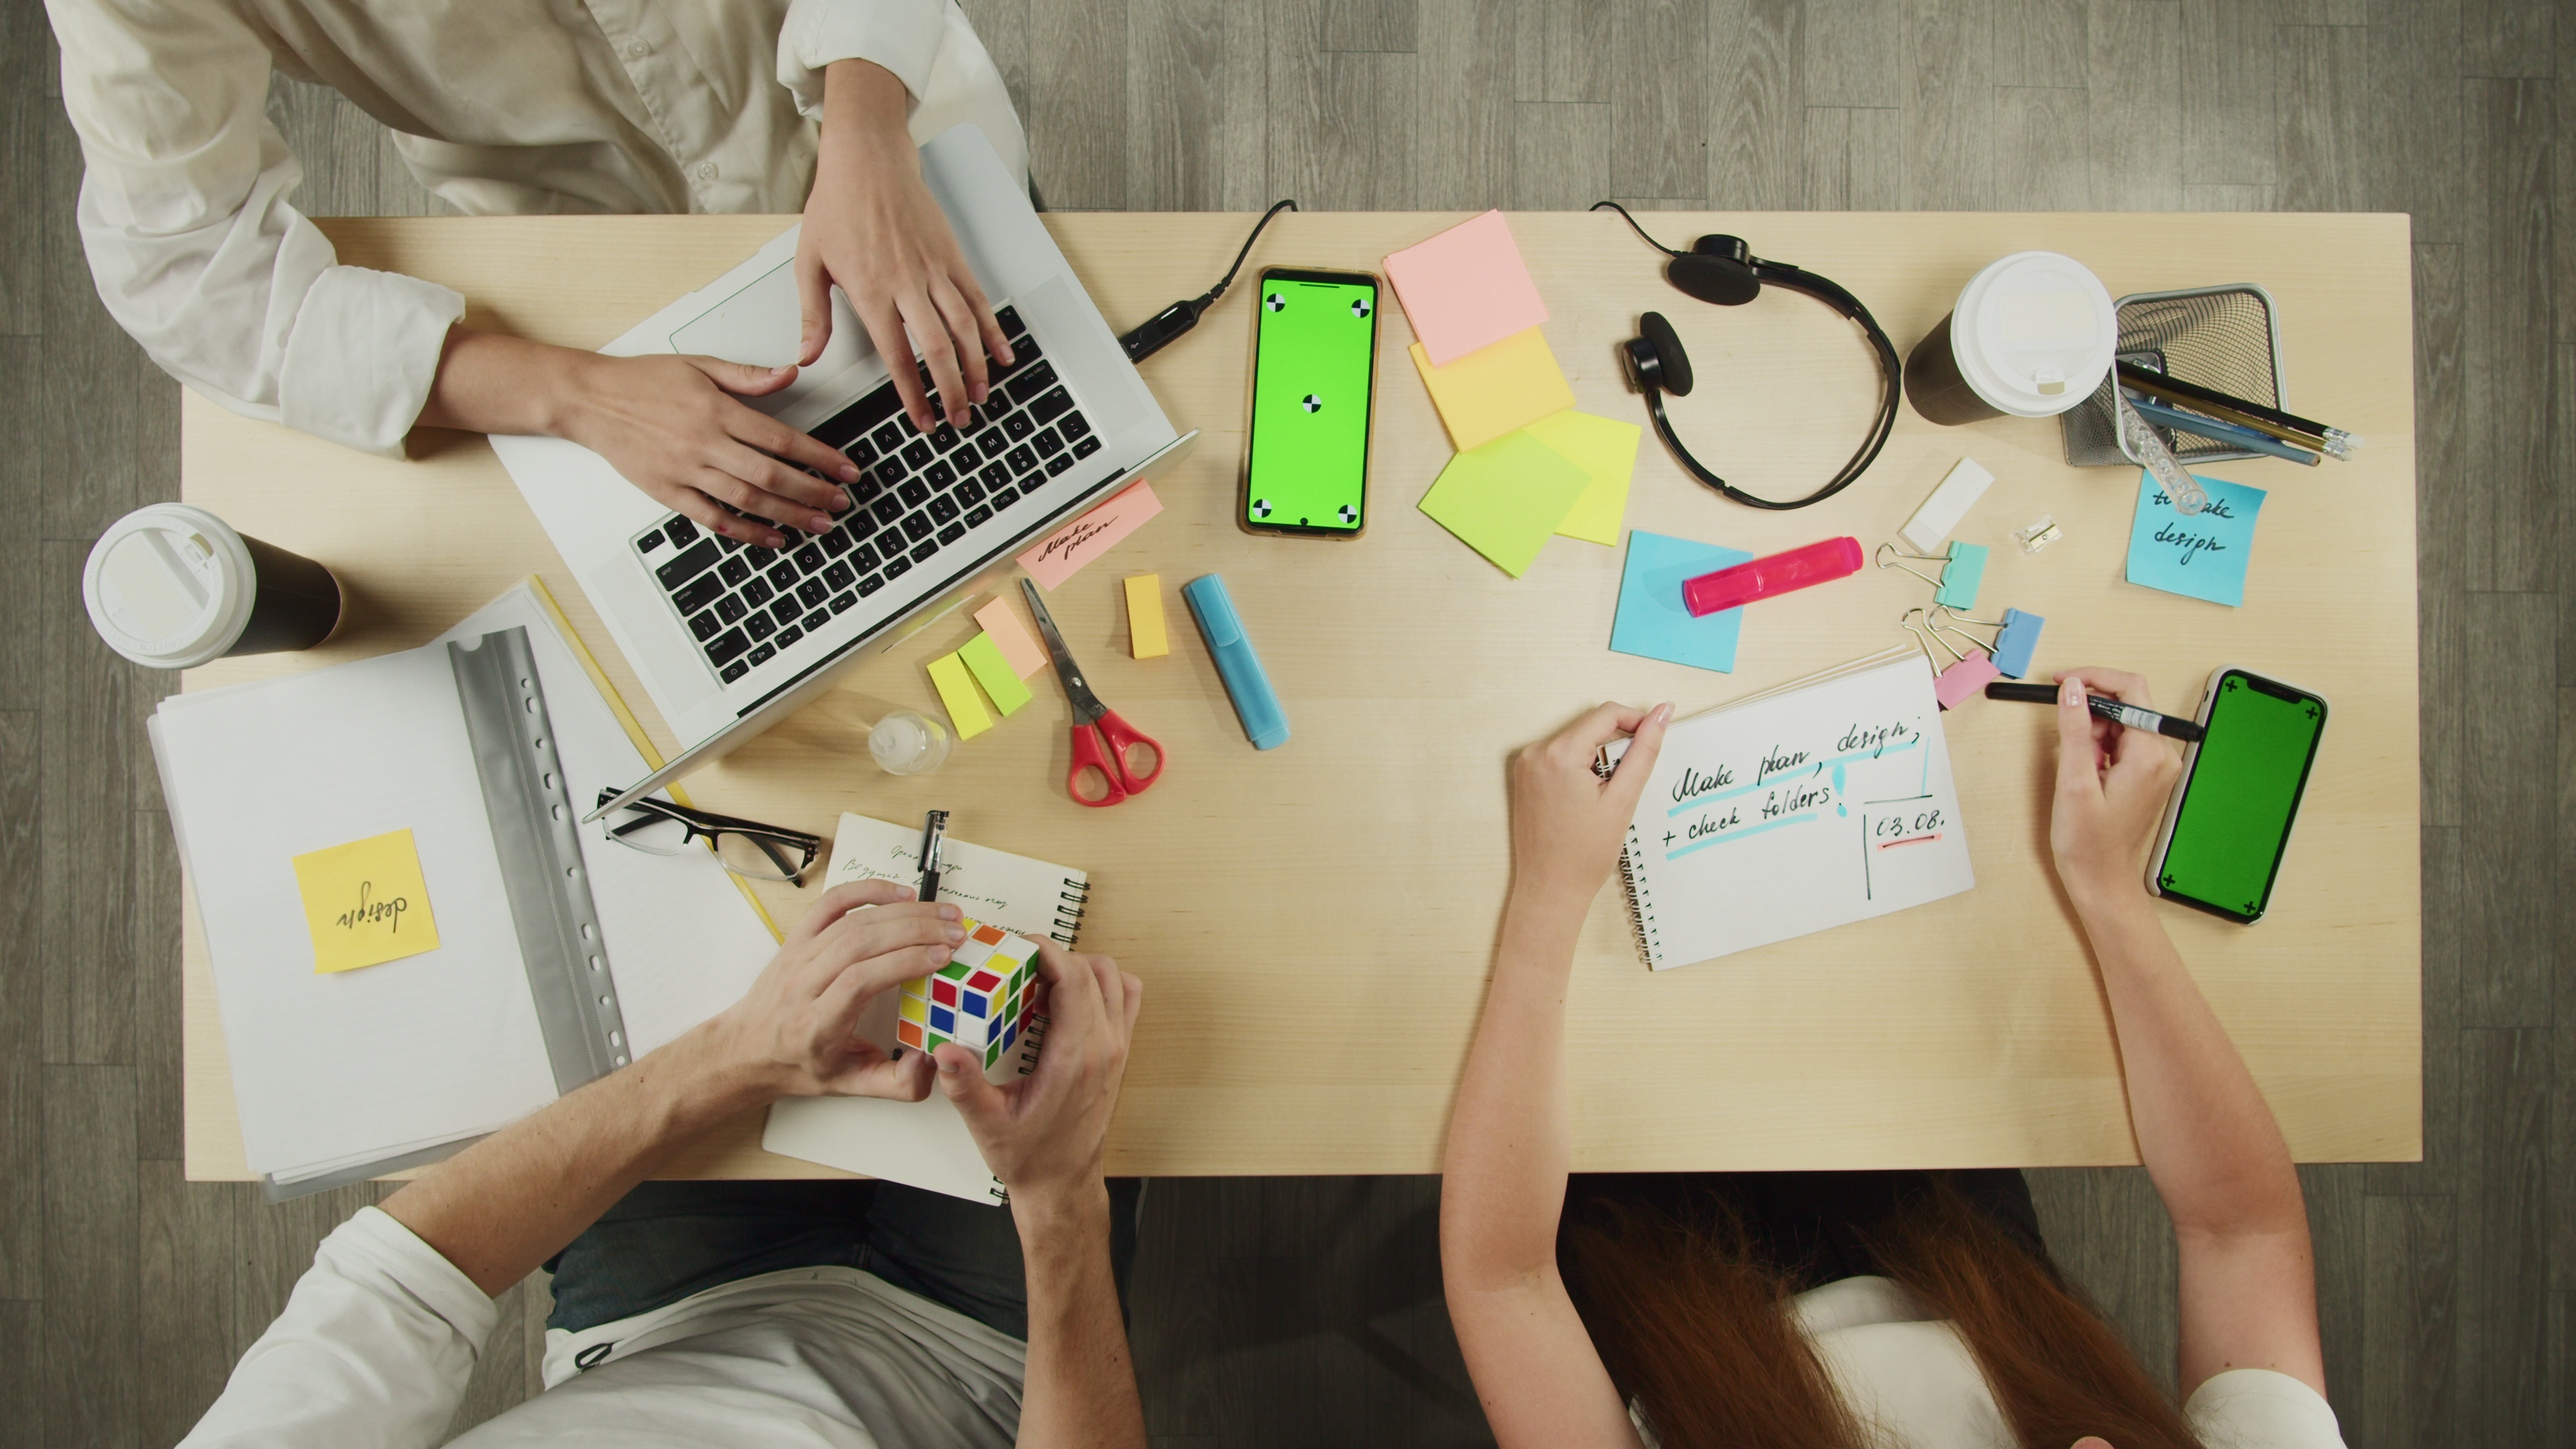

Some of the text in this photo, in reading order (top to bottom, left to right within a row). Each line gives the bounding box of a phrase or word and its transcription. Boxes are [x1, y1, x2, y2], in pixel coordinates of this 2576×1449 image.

[1053, 390, 1062, 398] tab
[991, 400, 998, 409] A
[1014, 422, 1022, 430] Q
[885, 434, 892, 442] V
[939, 434, 947, 442] D
[987, 438, 998, 448] W
[1082, 443, 1091, 451] esc
[858, 450, 865, 458] B
[914, 451, 921, 459] F
[1015, 451, 1022, 460] 2
[962, 455, 969, 464] E
[887, 468, 894, 476] G
[936, 472, 943, 480] R
[989, 468, 996, 476] 3
[861, 484, 869, 492] H
[911, 489, 917, 497] T
[858, 522, 865, 531] U
[1038, 522, 1094, 562] Make
[1063, 515, 1119, 560] plan
[2154, 521, 2226, 566] design
[805, 555, 813, 564] O
[780, 571, 787, 580] P
[833, 568, 839, 576] 9
[709, 639, 725, 651] delete
[1672, 767, 1734, 802] Make
[1688, 807, 1741, 841] check
[335, 880, 407, 934] design
